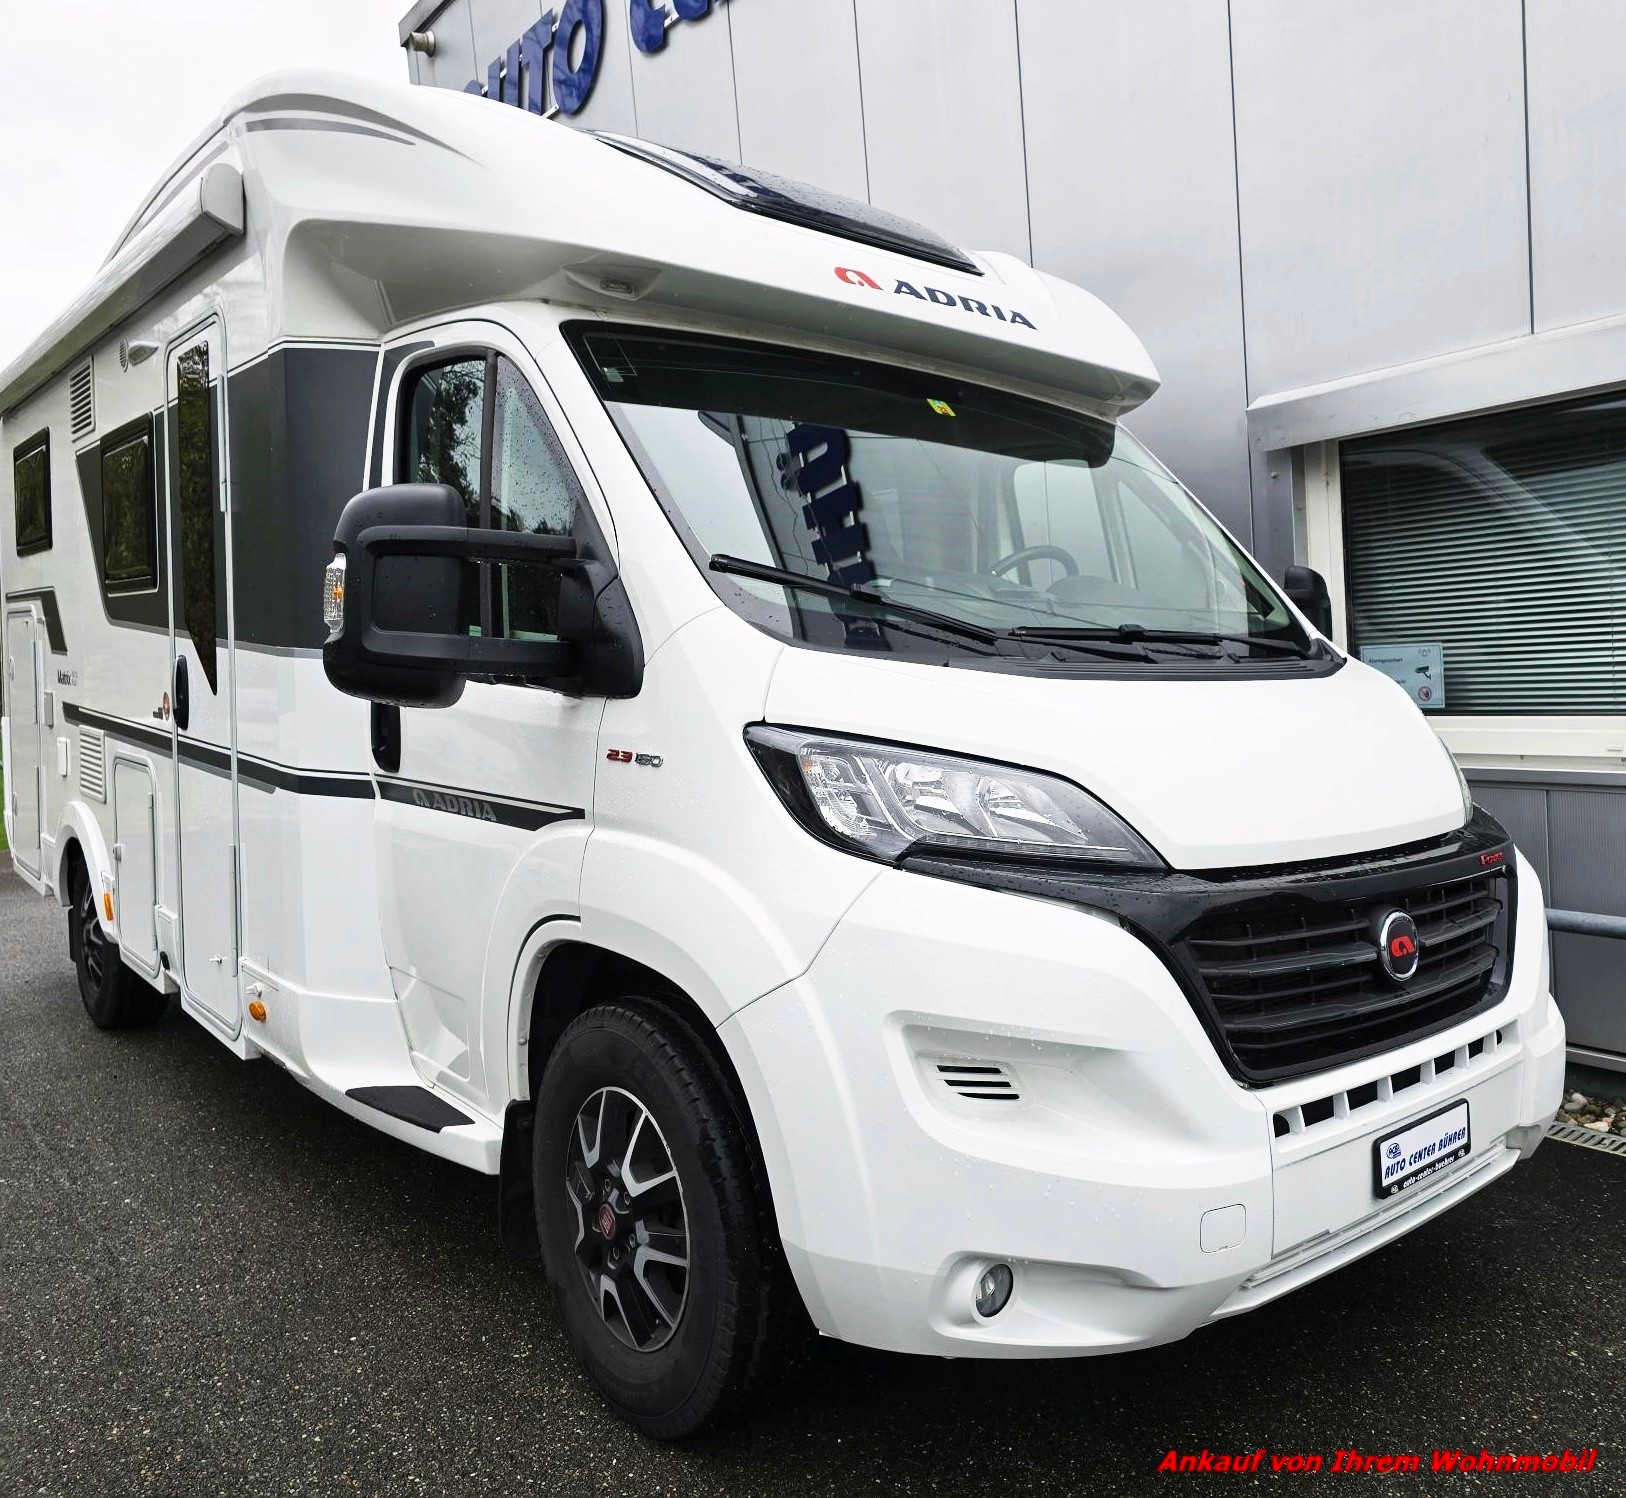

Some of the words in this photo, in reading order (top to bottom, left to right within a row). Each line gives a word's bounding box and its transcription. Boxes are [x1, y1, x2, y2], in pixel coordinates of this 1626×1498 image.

[893, 279, 1038, 331] ADRIA
[432, 792, 497, 822] ADRIA
[1384, 1158, 1406, 1179] AUTO
[1408, 1142, 1436, 1167] CENTER
[1438, 1127, 1466, 1152] BÜHRER
